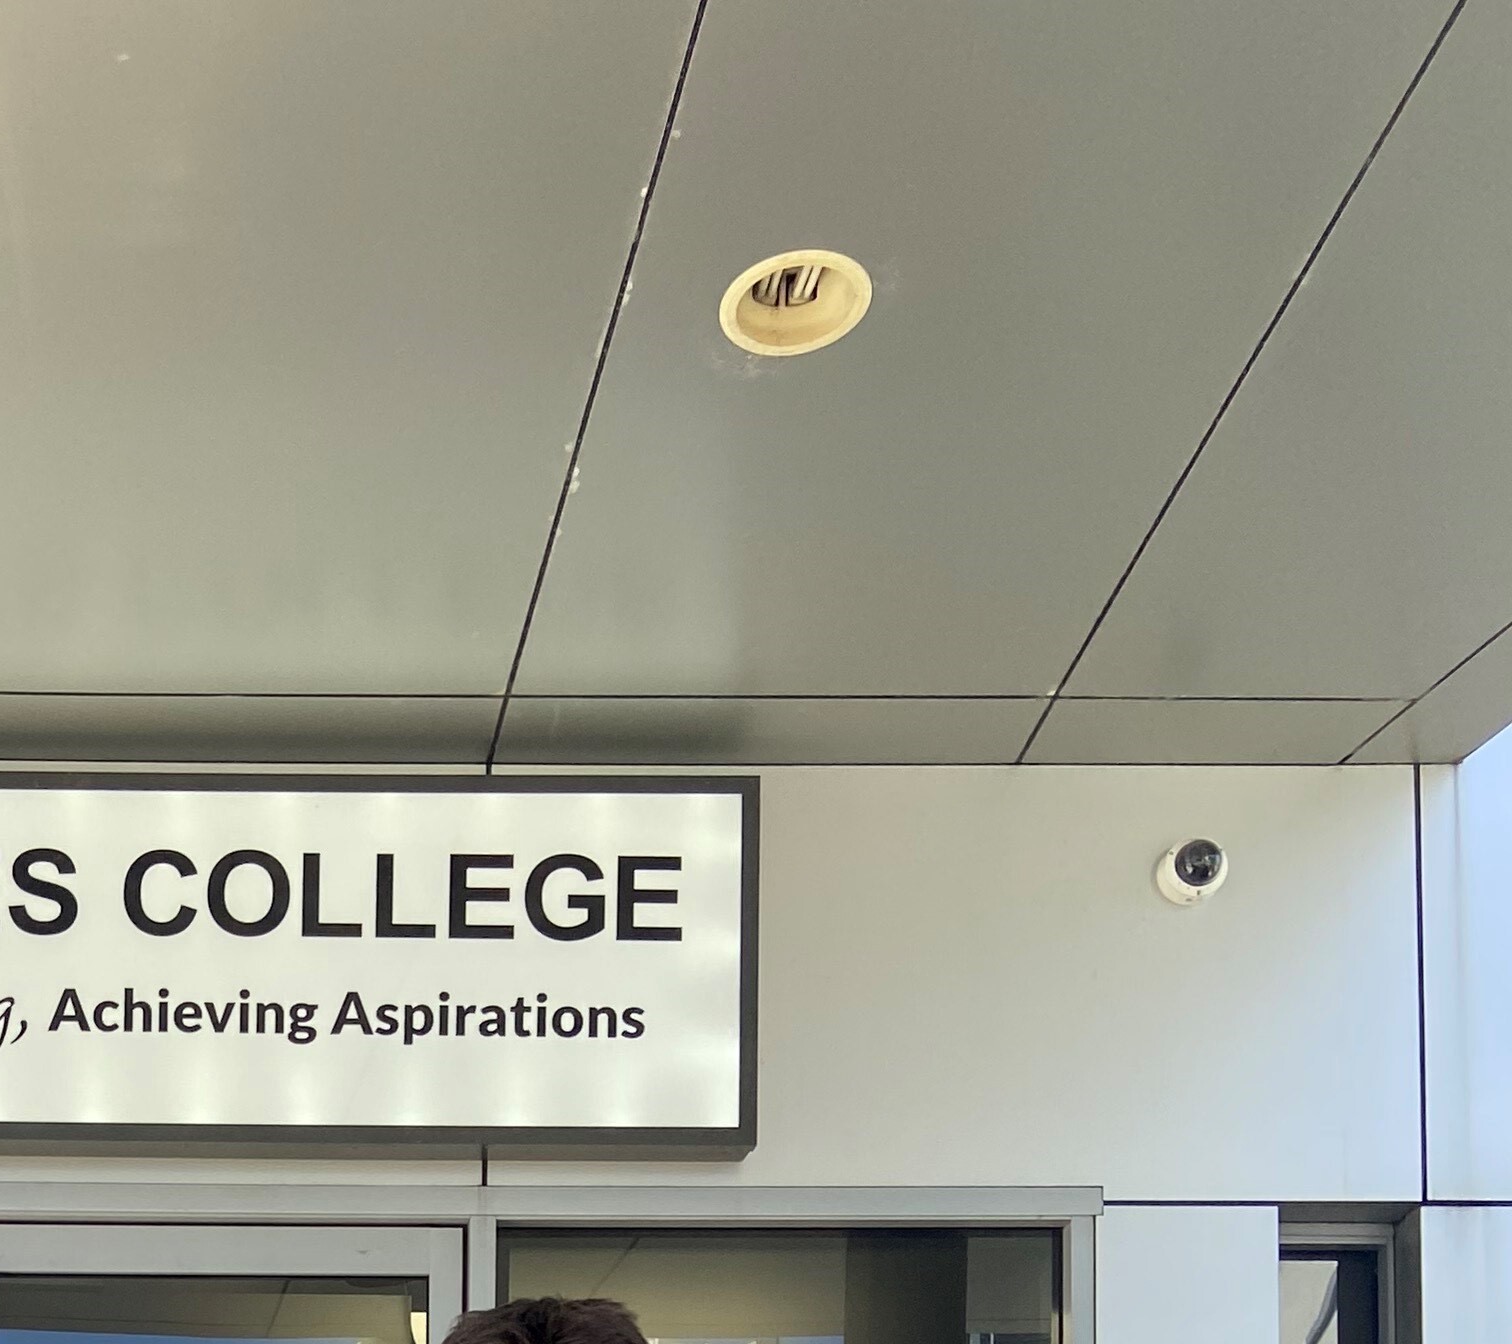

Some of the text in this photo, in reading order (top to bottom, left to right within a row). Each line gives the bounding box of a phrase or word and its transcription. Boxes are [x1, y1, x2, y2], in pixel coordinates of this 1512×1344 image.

[124, 850, 681, 941] COLLEGE
[49, 988, 318, 1044] Achieving
[331, 992, 644, 1044] Aspirations
